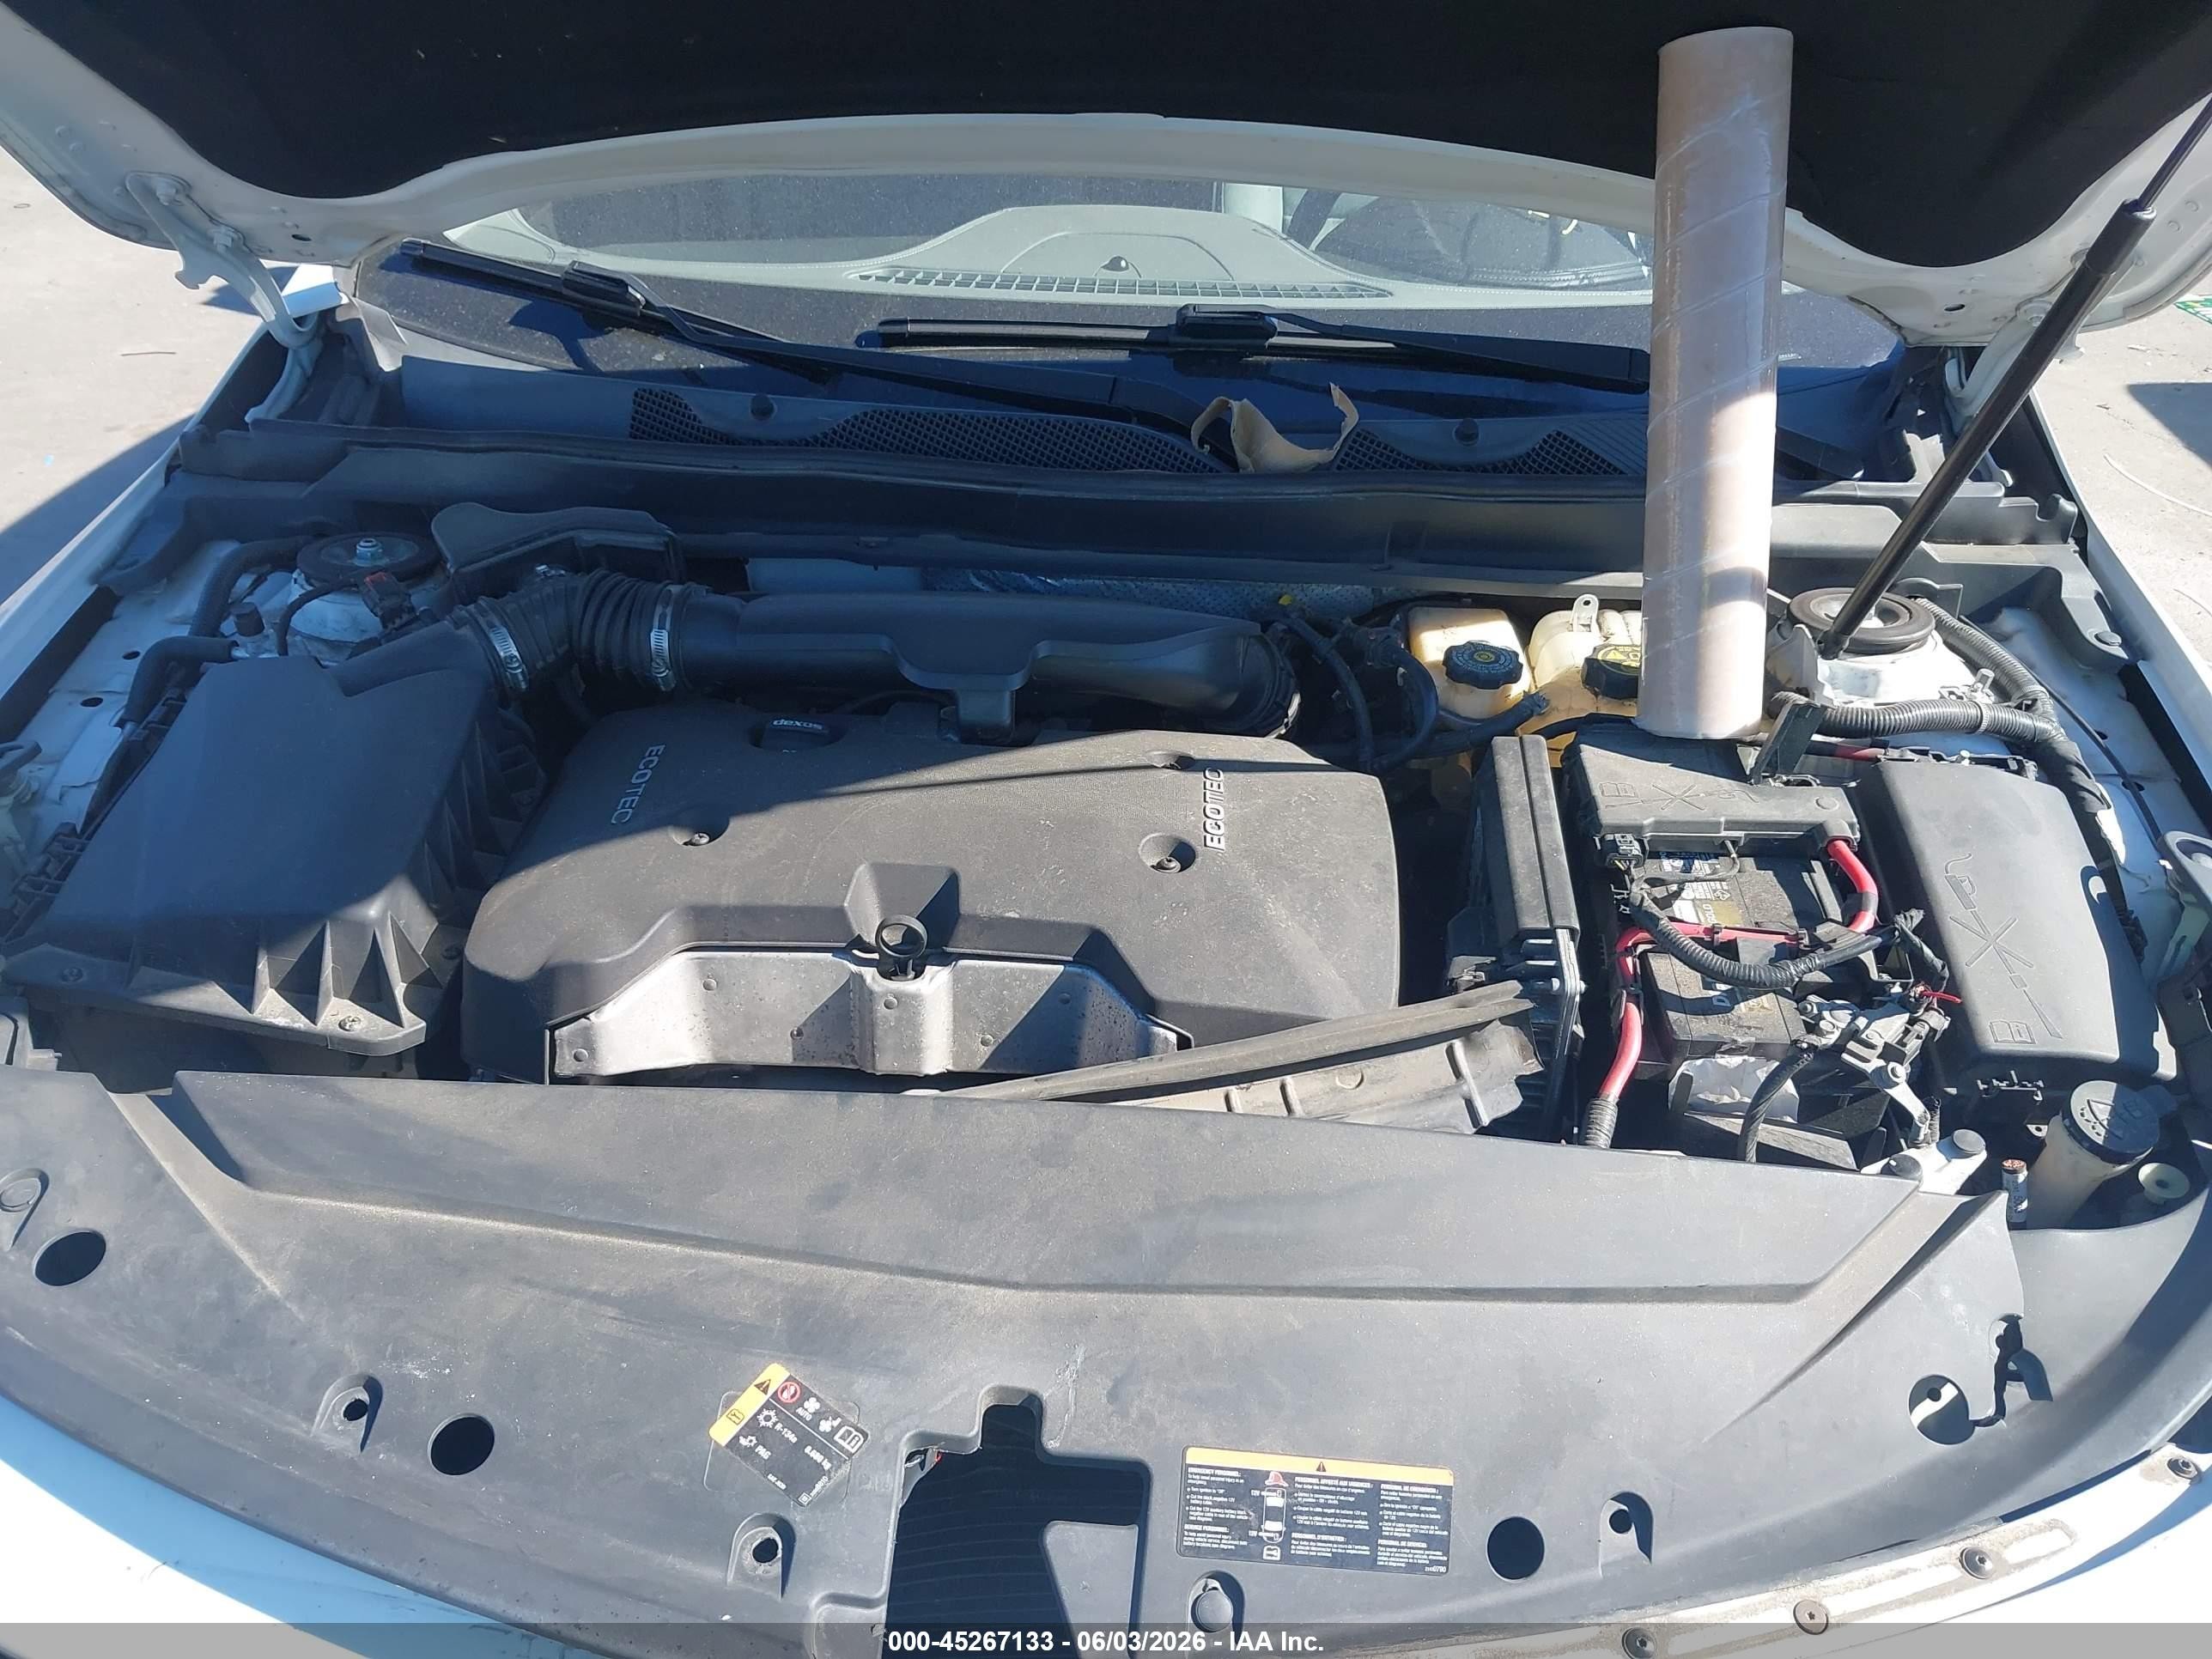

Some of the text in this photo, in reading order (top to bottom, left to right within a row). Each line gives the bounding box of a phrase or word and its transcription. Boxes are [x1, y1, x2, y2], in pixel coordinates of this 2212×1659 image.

[773, 719, 823, 730] dexos
[611, 744, 666, 825] ECOTEC
[1203, 767, 1225, 851] ECOTEC
[796, 1407, 812, 1421] AUTO
[774, 1422, 798, 1443] R-134a
[755, 1443, 772, 1460] PAG
